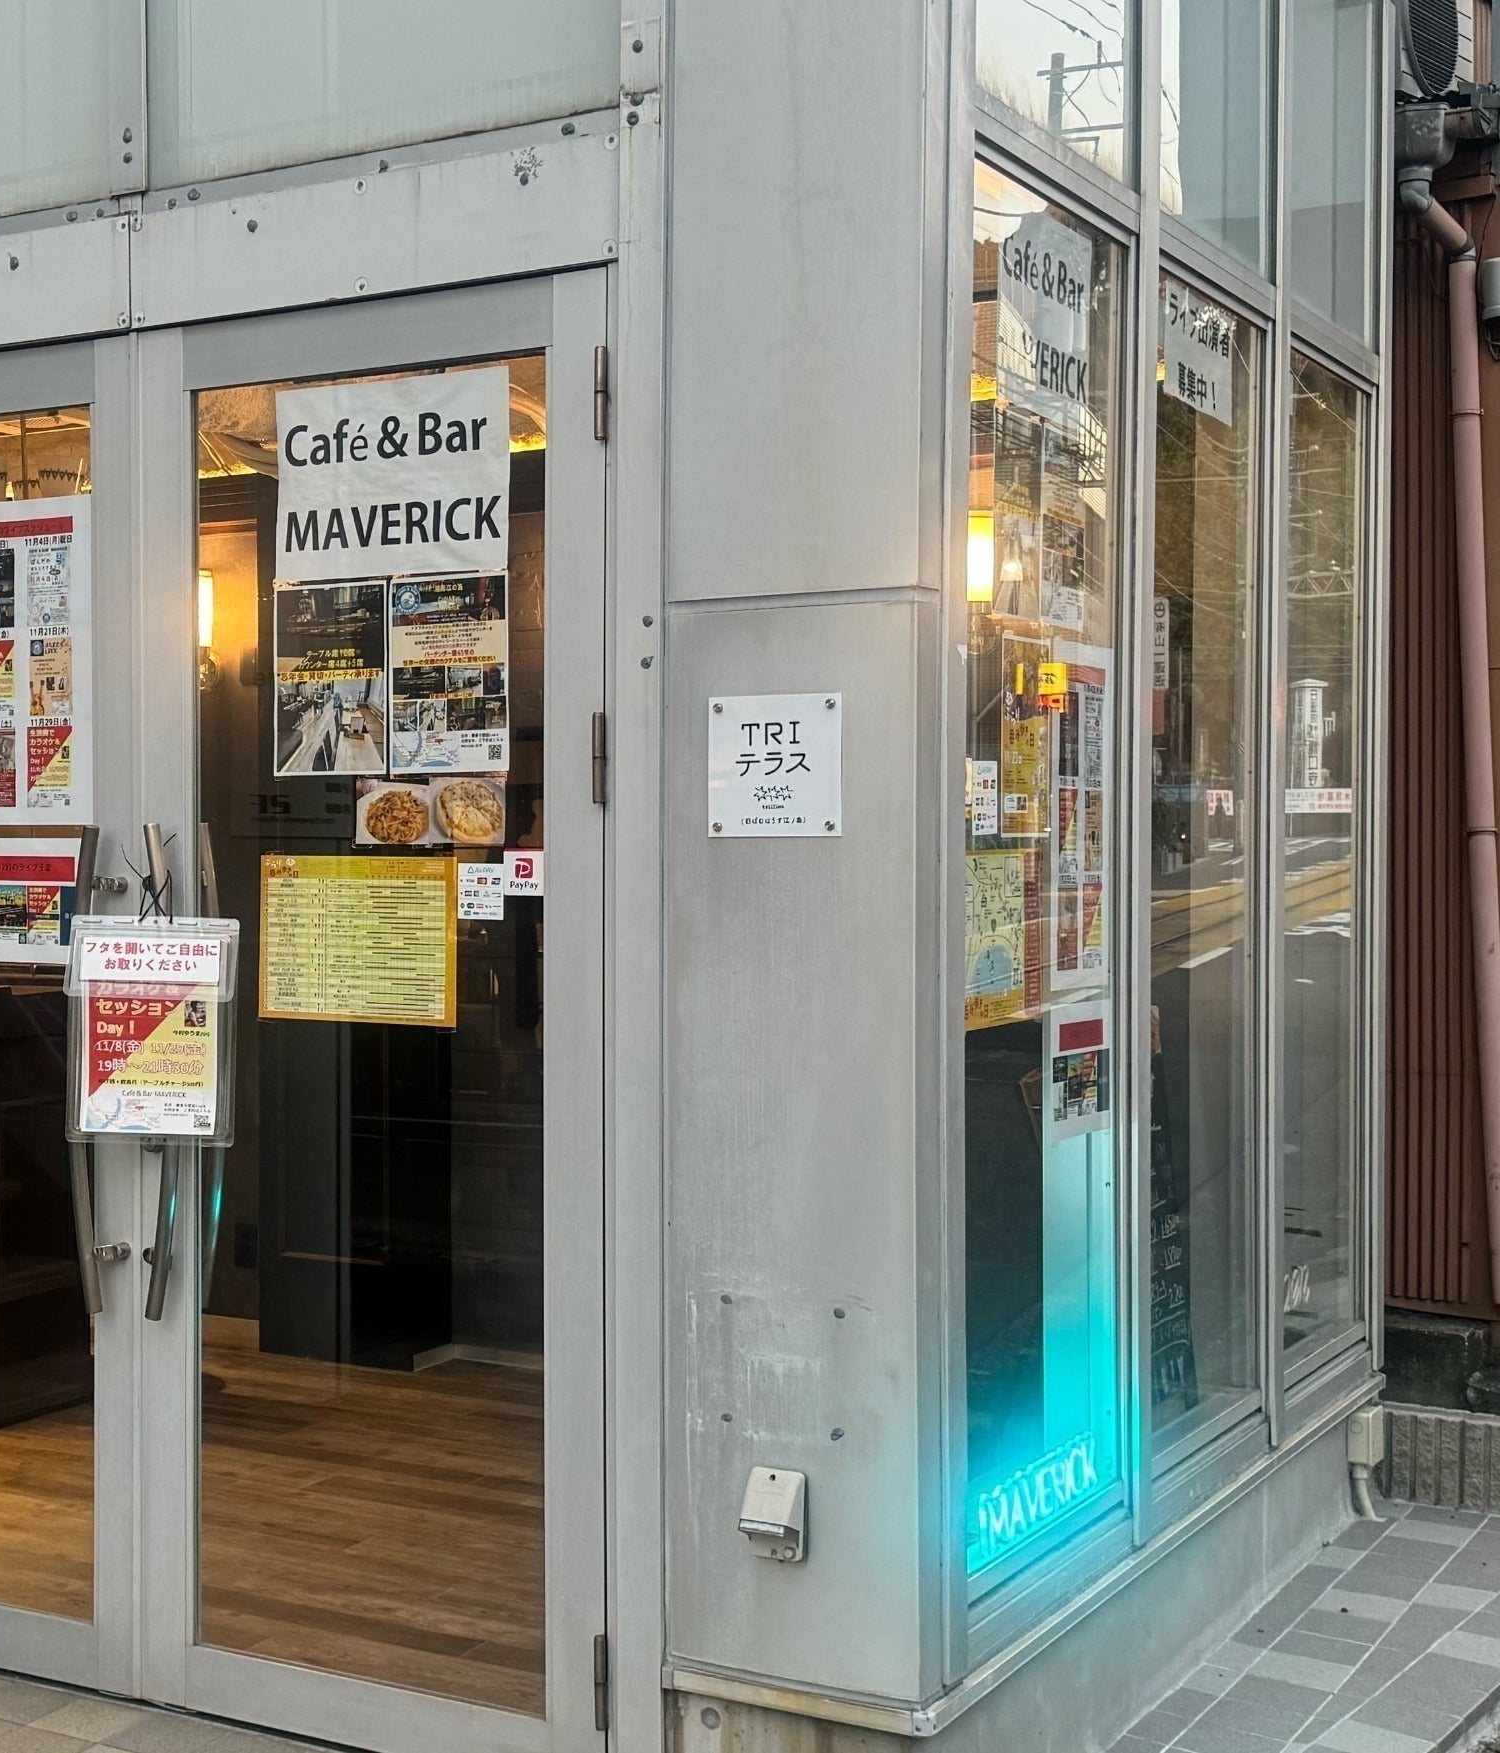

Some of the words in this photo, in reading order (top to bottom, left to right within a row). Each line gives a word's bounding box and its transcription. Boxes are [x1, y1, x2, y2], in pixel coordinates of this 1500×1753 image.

[1002, 235, 1039, 291] Café
[1042, 252, 1054, 300] &
[1057, 260, 1084, 314] Bar
[285, 418, 368, 467] Café
[376, 416, 408, 459] &
[418, 412, 487, 456] Bar
[285, 495, 501, 552] MAVERICK
[741, 721, 801, 746] TRI
[735, 752, 811, 777] テラス
[510, 881, 538, 890] PayPay
[86, 942, 218, 957] フタを開いてご自由に
[104, 958, 197, 972] お取りください
[154, 1090, 187, 1099] MAVERICK
[986, 1442, 1098, 1554] MAVERICK
